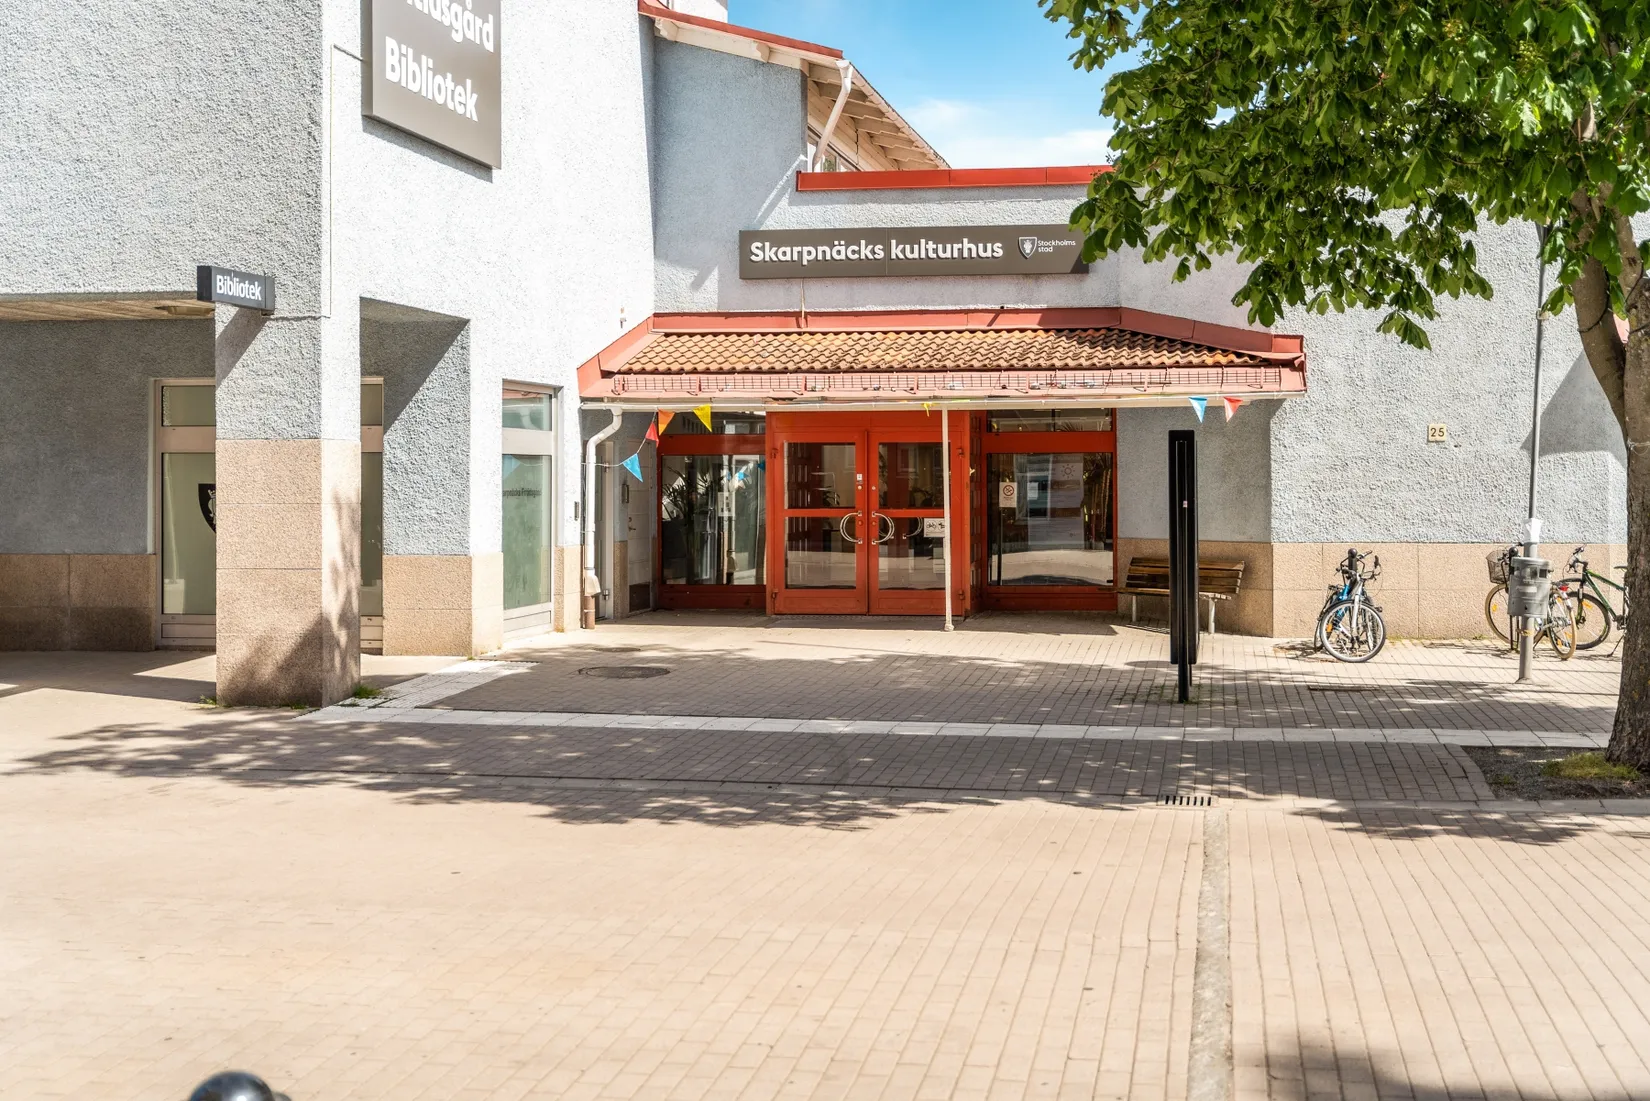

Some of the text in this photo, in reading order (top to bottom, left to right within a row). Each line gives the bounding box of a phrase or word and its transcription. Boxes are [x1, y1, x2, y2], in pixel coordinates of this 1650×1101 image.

[385, 36, 478, 122] Bibliotek
[750, 238, 1004, 266] Skarpnäcks kulturhus
[1037, 239, 1076, 247] Stockholms
[216, 274, 262, 301] Bibliotek
[1430, 427, 1445, 437] 25
